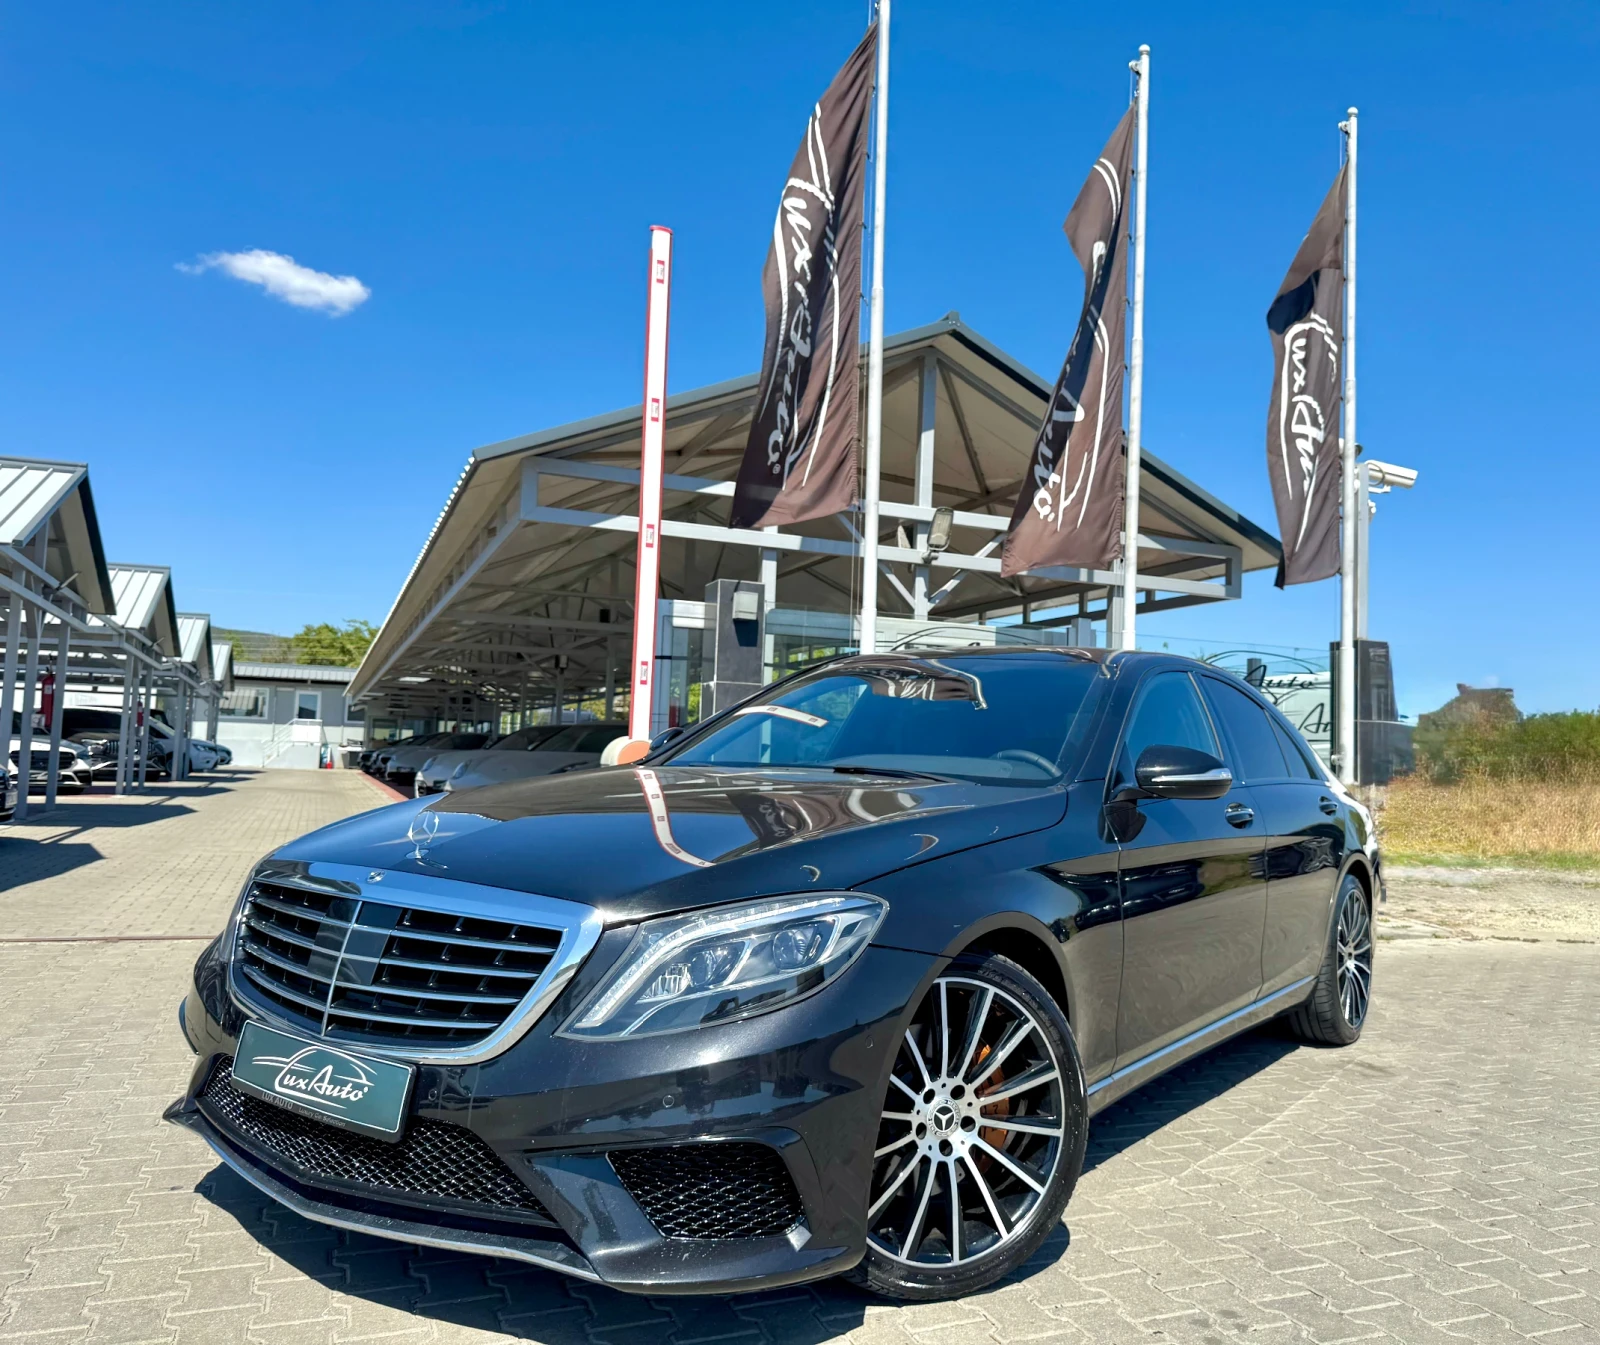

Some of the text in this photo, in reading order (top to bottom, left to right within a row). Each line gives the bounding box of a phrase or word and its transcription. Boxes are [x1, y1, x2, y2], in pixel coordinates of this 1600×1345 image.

[1243, 664, 1318, 690] Auto
[261, 1091, 275, 1102] LUX
[274, 1097, 294, 1110] AUTO
